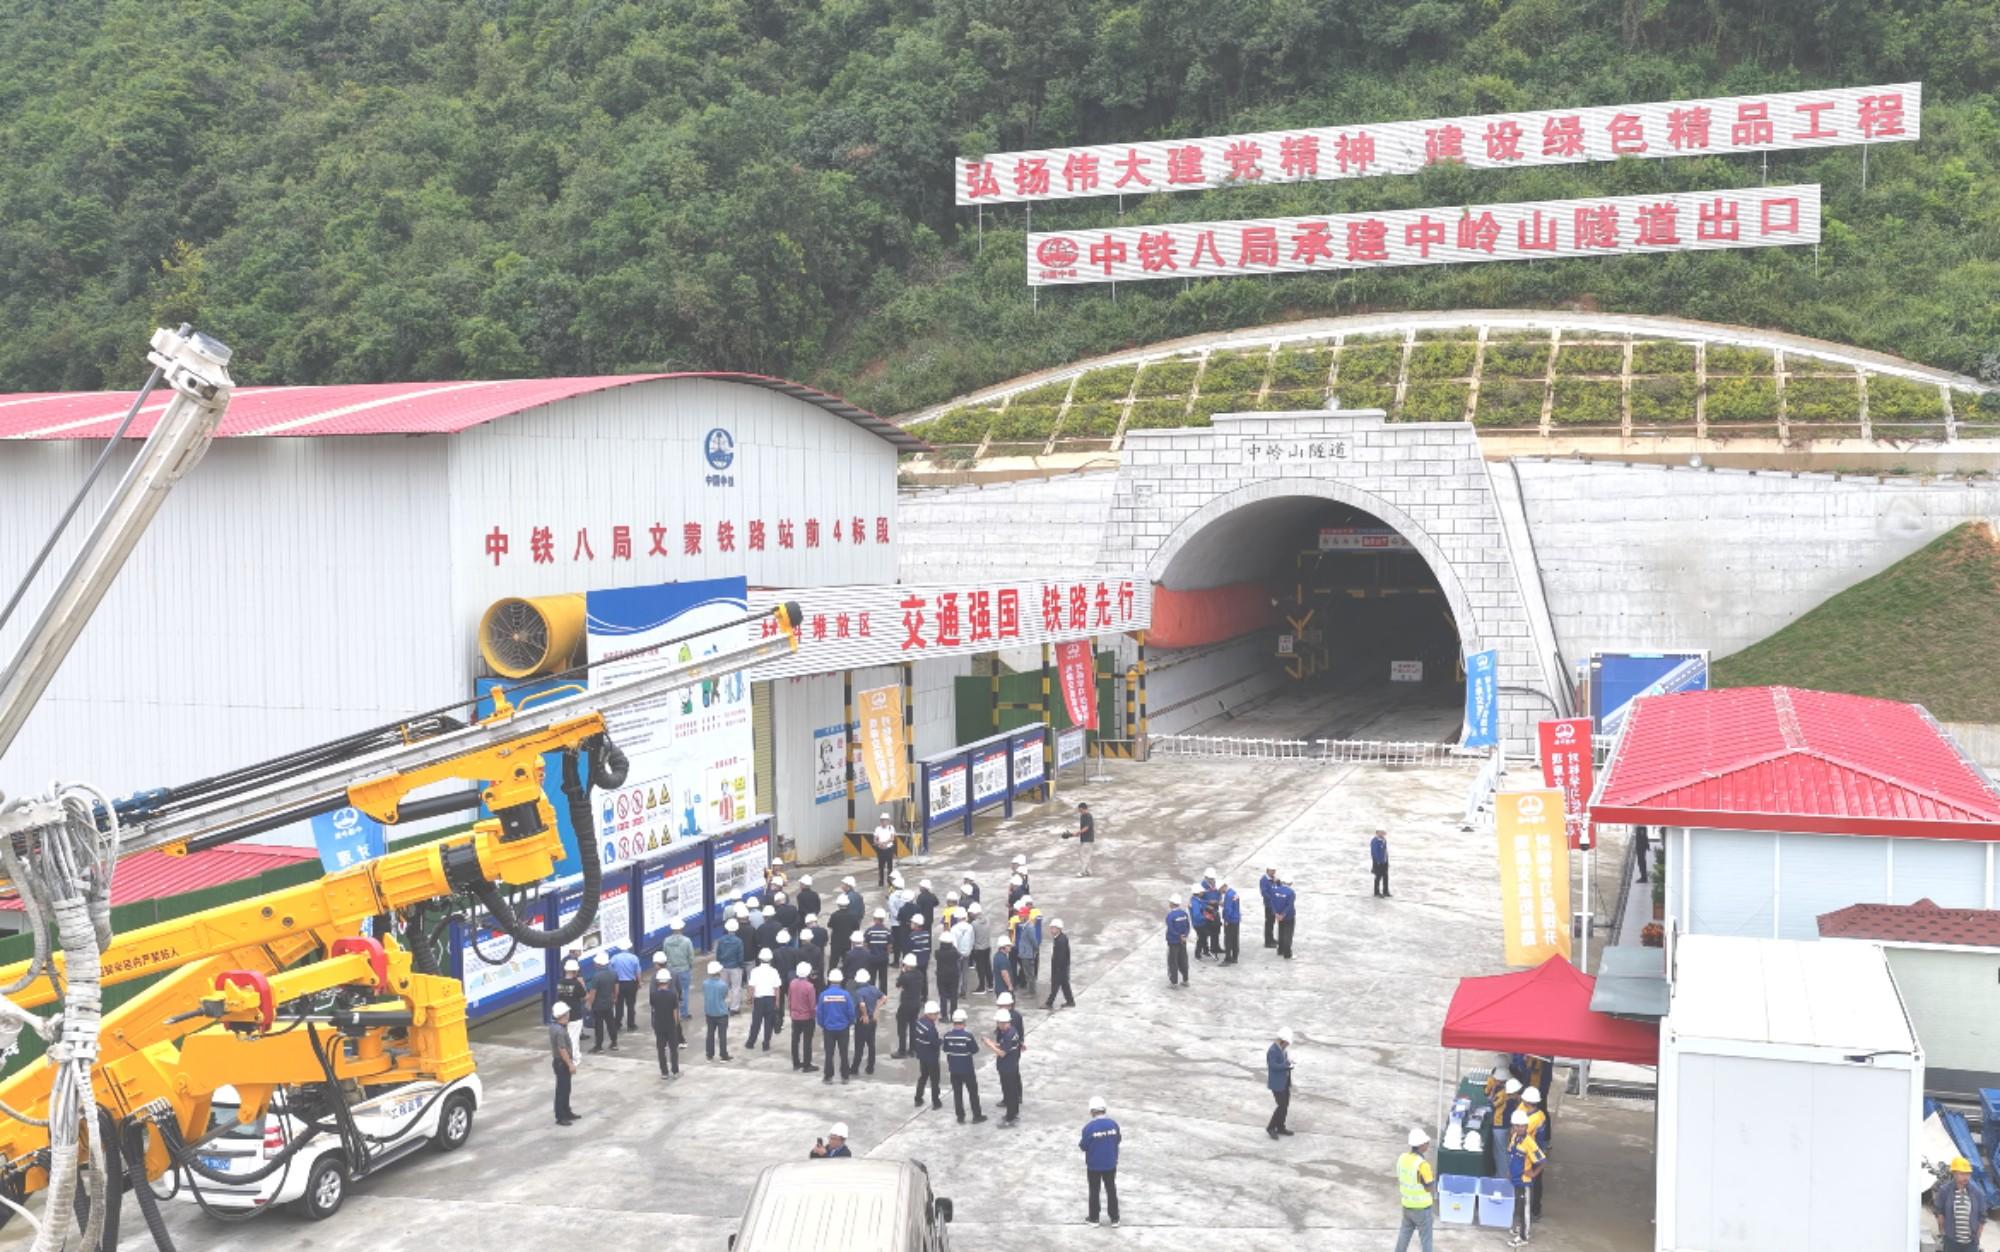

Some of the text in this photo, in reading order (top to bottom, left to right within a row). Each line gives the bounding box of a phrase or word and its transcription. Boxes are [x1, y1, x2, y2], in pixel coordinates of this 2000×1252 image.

[965, 94, 1906, 199] 弘扬伟大建党精神 建设绿色精品工程
[1090, 197, 1800, 275] 中铁八局承建中岭山隧道出口
[1247, 441, 1347, 461] 中岭山隧道
[484, 515, 891, 566] 中铁八局文蒙铁路站前4标段
[900, 581, 1134, 650] 交通强国 铁路先行
